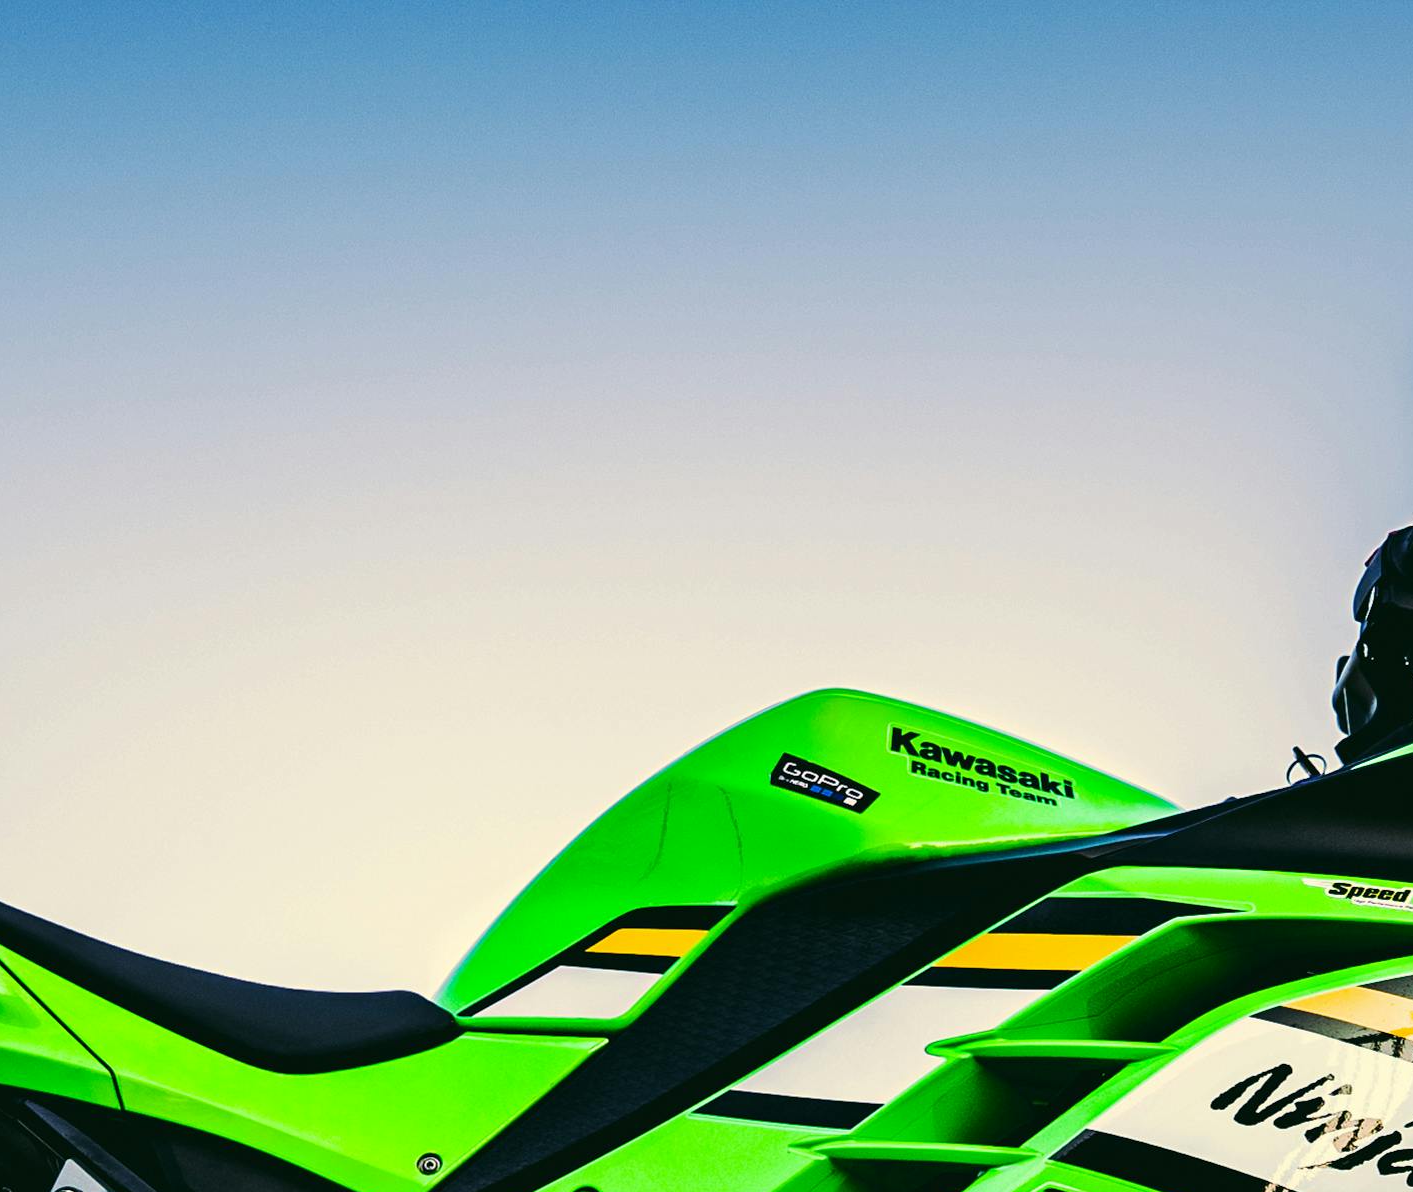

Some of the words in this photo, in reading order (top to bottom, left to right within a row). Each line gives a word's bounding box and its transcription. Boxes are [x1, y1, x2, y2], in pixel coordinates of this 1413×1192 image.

[782, 762, 864, 800] GoPro
[891, 727, 1075, 799] Kawasaki
[911, 760, 989, 792] Racing
[996, 782, 1057, 806] Team
[1328, 882, 1411, 903] Speed
